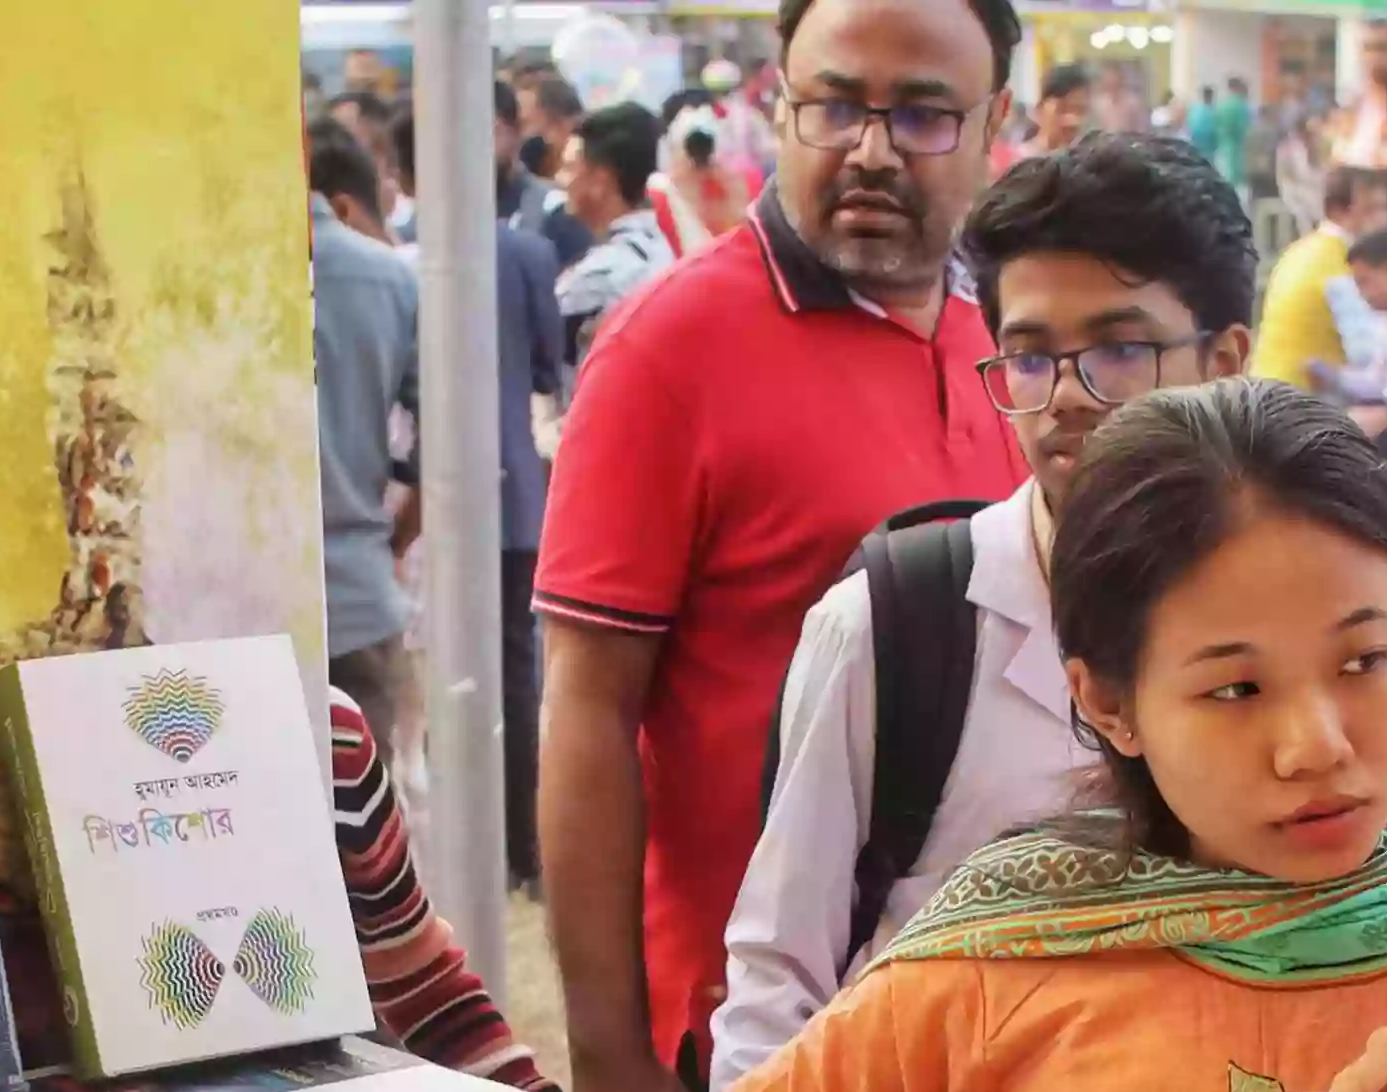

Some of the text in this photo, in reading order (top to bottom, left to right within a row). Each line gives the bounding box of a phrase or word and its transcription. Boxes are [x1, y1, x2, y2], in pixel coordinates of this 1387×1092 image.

[133, 768, 241, 800] হুমায়ূন আহমেদ
[82, 806, 235, 853] শিশুকিশোর
